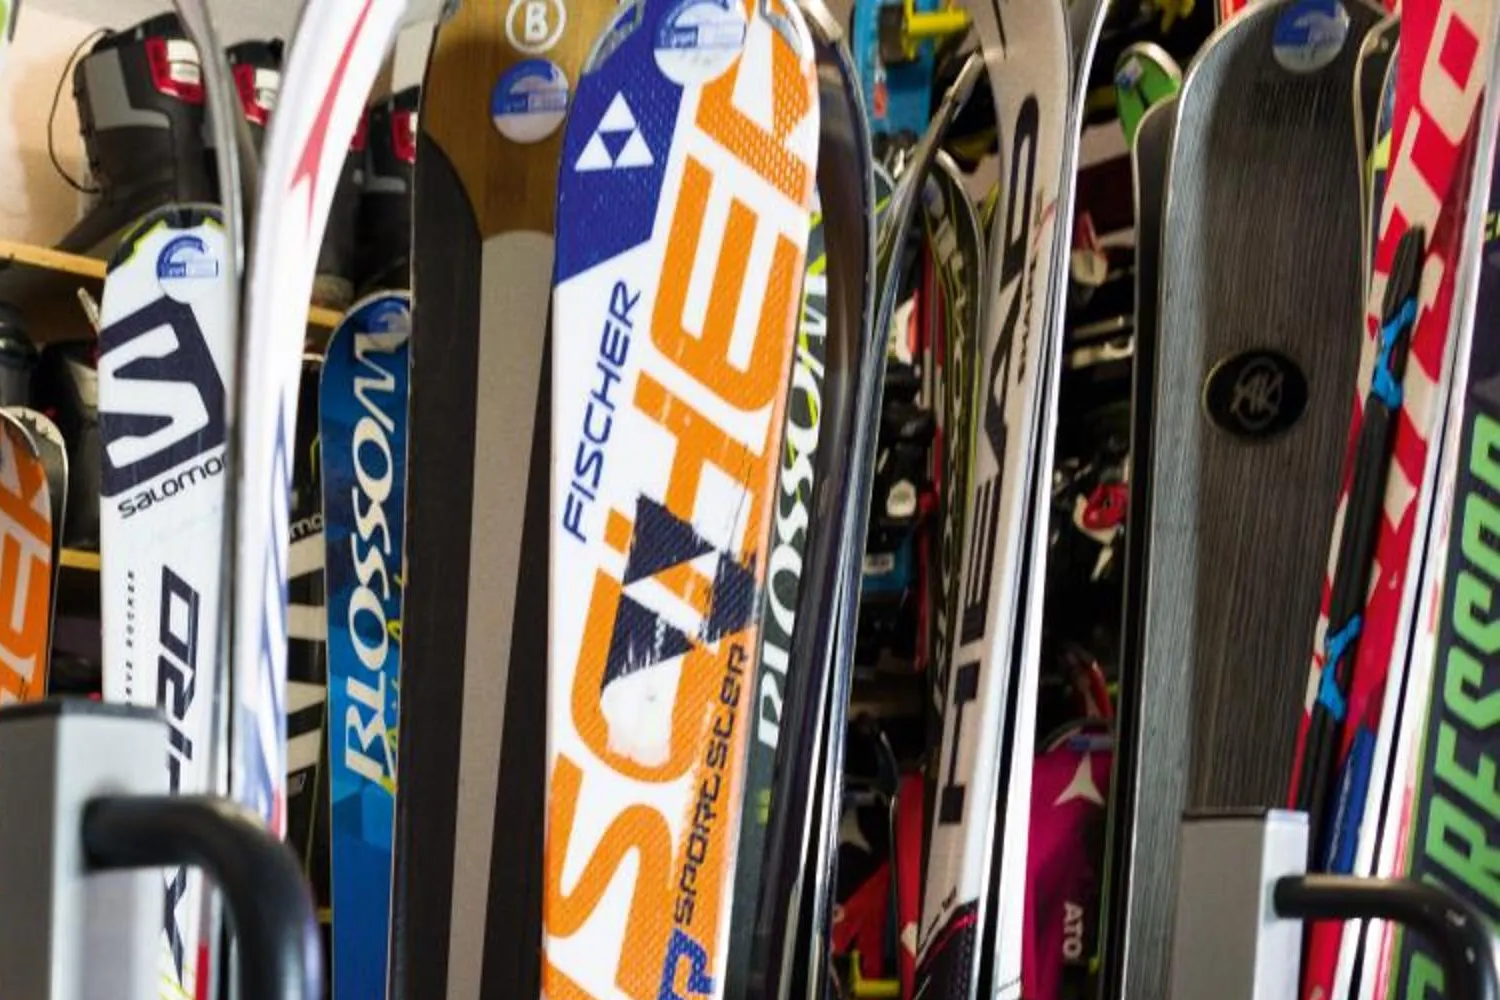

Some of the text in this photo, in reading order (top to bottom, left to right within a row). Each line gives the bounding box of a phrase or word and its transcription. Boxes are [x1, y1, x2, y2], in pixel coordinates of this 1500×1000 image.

[117, 452, 228, 521] salomo
[563, 279, 643, 543] FISCHER
[938, 93, 1039, 826] HEAD
[345, 332, 397, 793] BLOSSOM
[1062, 901, 1084, 960] ATO
